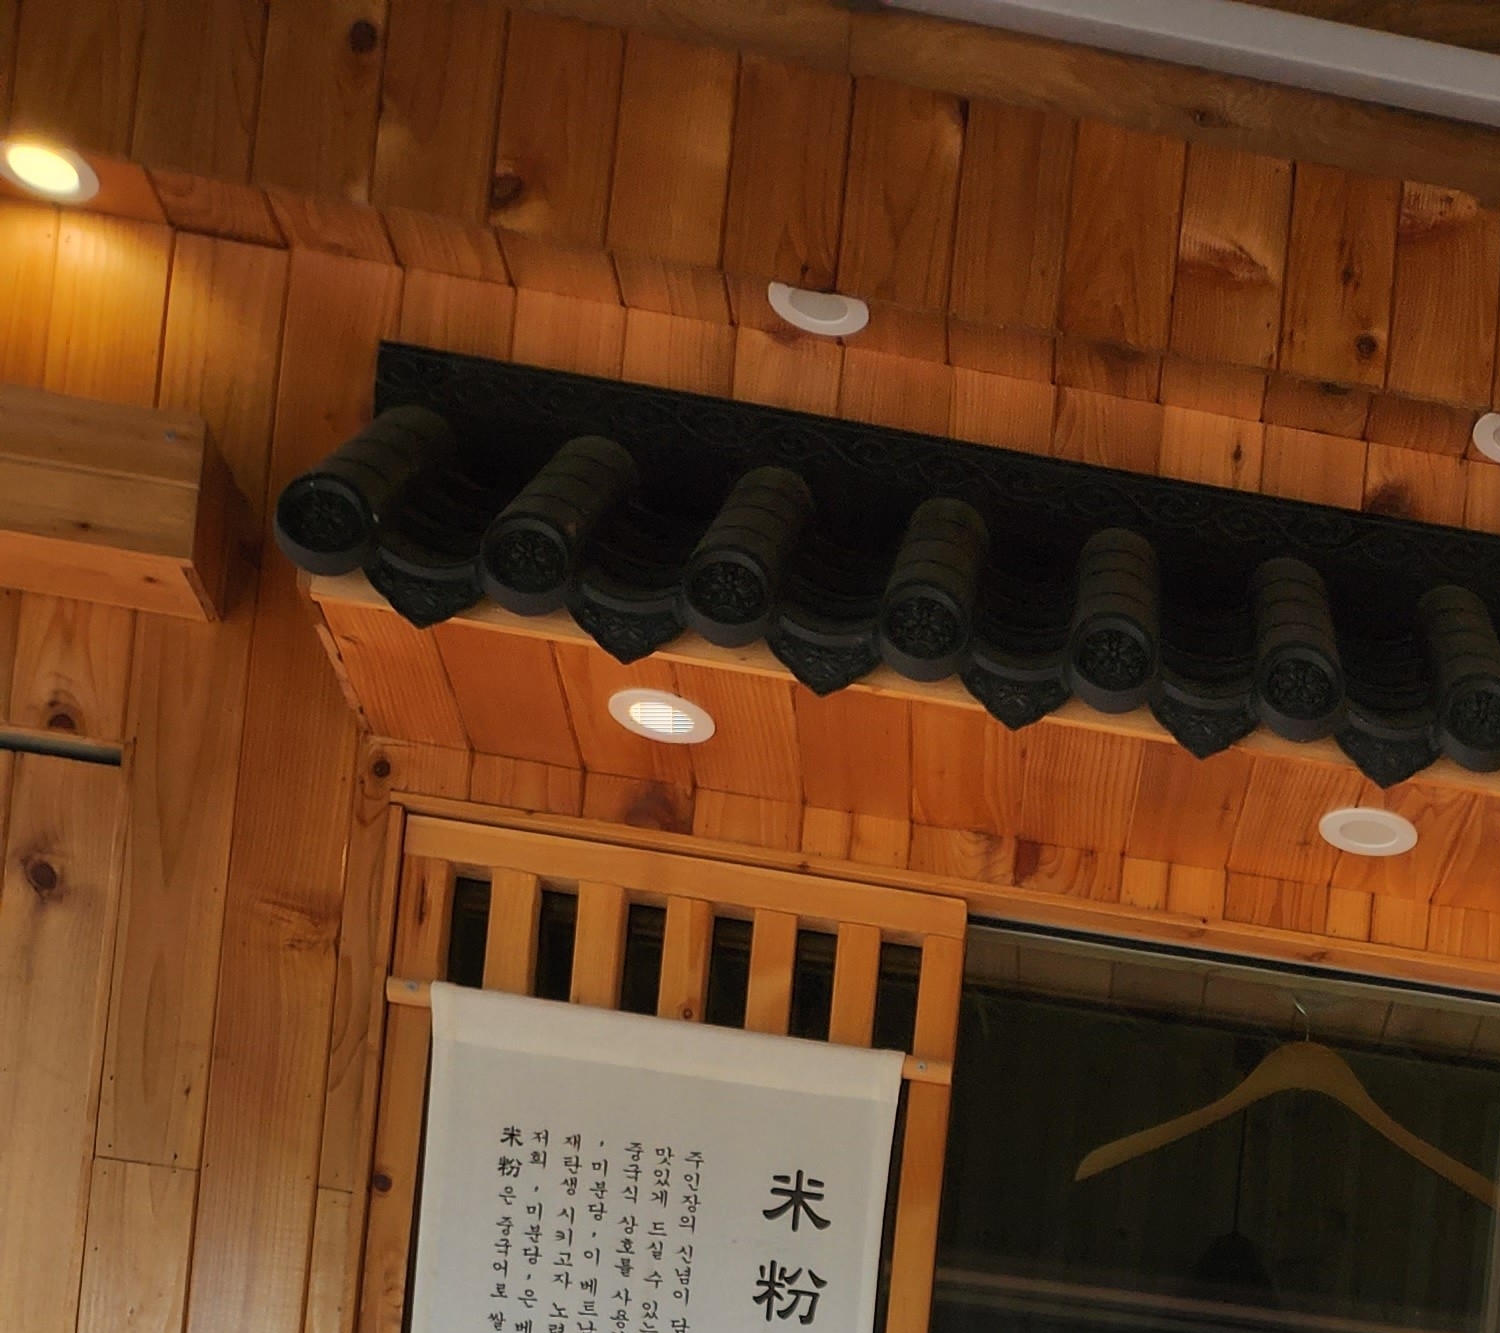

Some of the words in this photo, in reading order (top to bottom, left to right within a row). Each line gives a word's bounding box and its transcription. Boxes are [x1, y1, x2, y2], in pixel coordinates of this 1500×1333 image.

[529, 1128, 549, 1169] 저희
[560, 1133, 583, 1196] 재탄생
[621, 1142, 645, 1204] 중국식
[651, 1146, 675, 1208] 맛있게
[678, 1151, 705, 1234] 주인장의
[489, 1216, 514, 1299] 중국어로
[553, 1206, 575, 1290] 시키고자
[614, 1214, 639, 1278] 상호를
[647, 1221, 668, 1261] 드실
[643, 1270, 664, 1289] 수
[672, 1244, 694, 1307] 신념이
